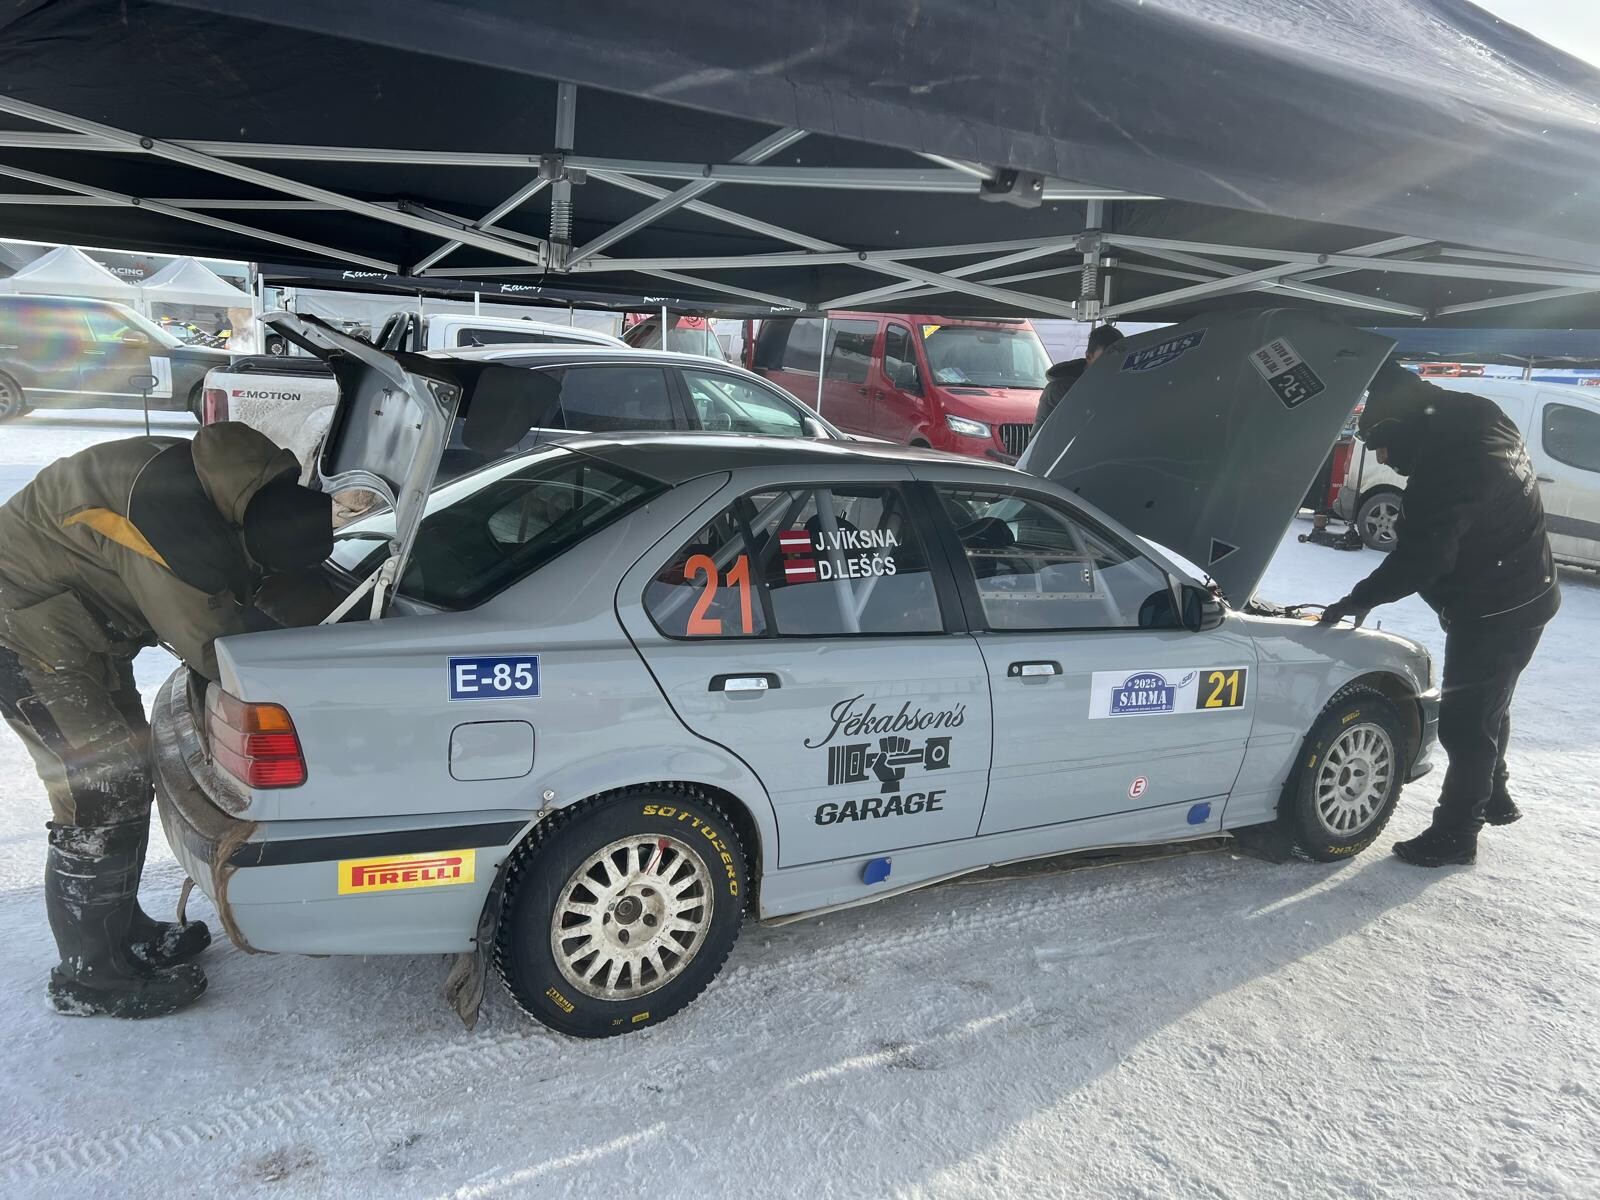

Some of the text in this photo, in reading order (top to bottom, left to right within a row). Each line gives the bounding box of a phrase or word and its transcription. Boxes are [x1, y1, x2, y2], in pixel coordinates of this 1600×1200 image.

[815, 527, 899, 551] J.VĪKSNA
[818, 552, 897, 580] D.LEŠČS
[683, 553, 754, 634] 21
[455, 663, 533, 692] E-85
[1133, 678, 1156, 689] 2025
[1204, 670, 1239, 708] 21
[1119, 690, 1167, 706] SARMA
[803, 693, 966, 749] Jēkabson's
[814, 789, 947, 826] GARAGE
[351, 857, 463, 887] PIRELLI
